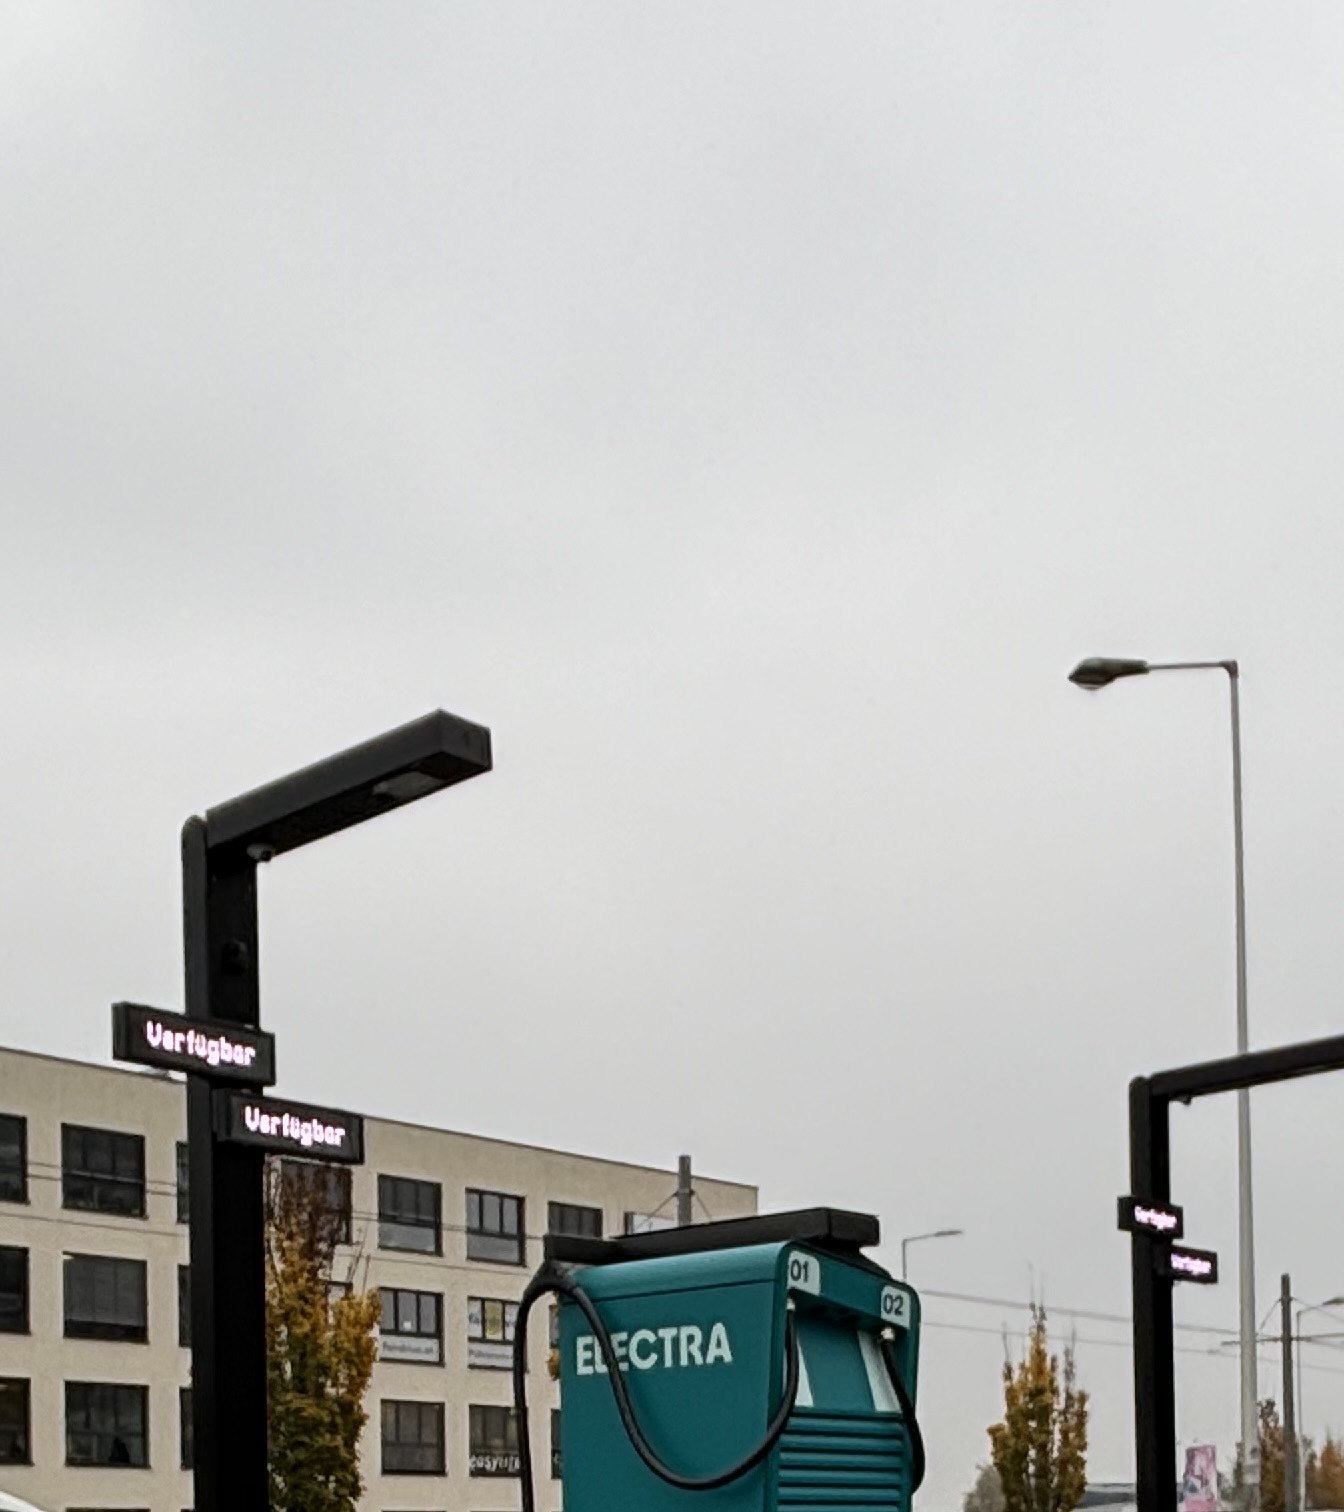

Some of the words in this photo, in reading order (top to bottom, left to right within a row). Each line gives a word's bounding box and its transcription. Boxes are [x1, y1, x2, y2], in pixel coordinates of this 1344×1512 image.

[146, 1020, 256, 1066] Verfügbar
[244, 1105, 346, 1146] Verfügbar
[790, 1258, 810, 1283] 01
[883, 1292, 904, 1316] 02
[576, 1322, 733, 1377] ELECTRA
